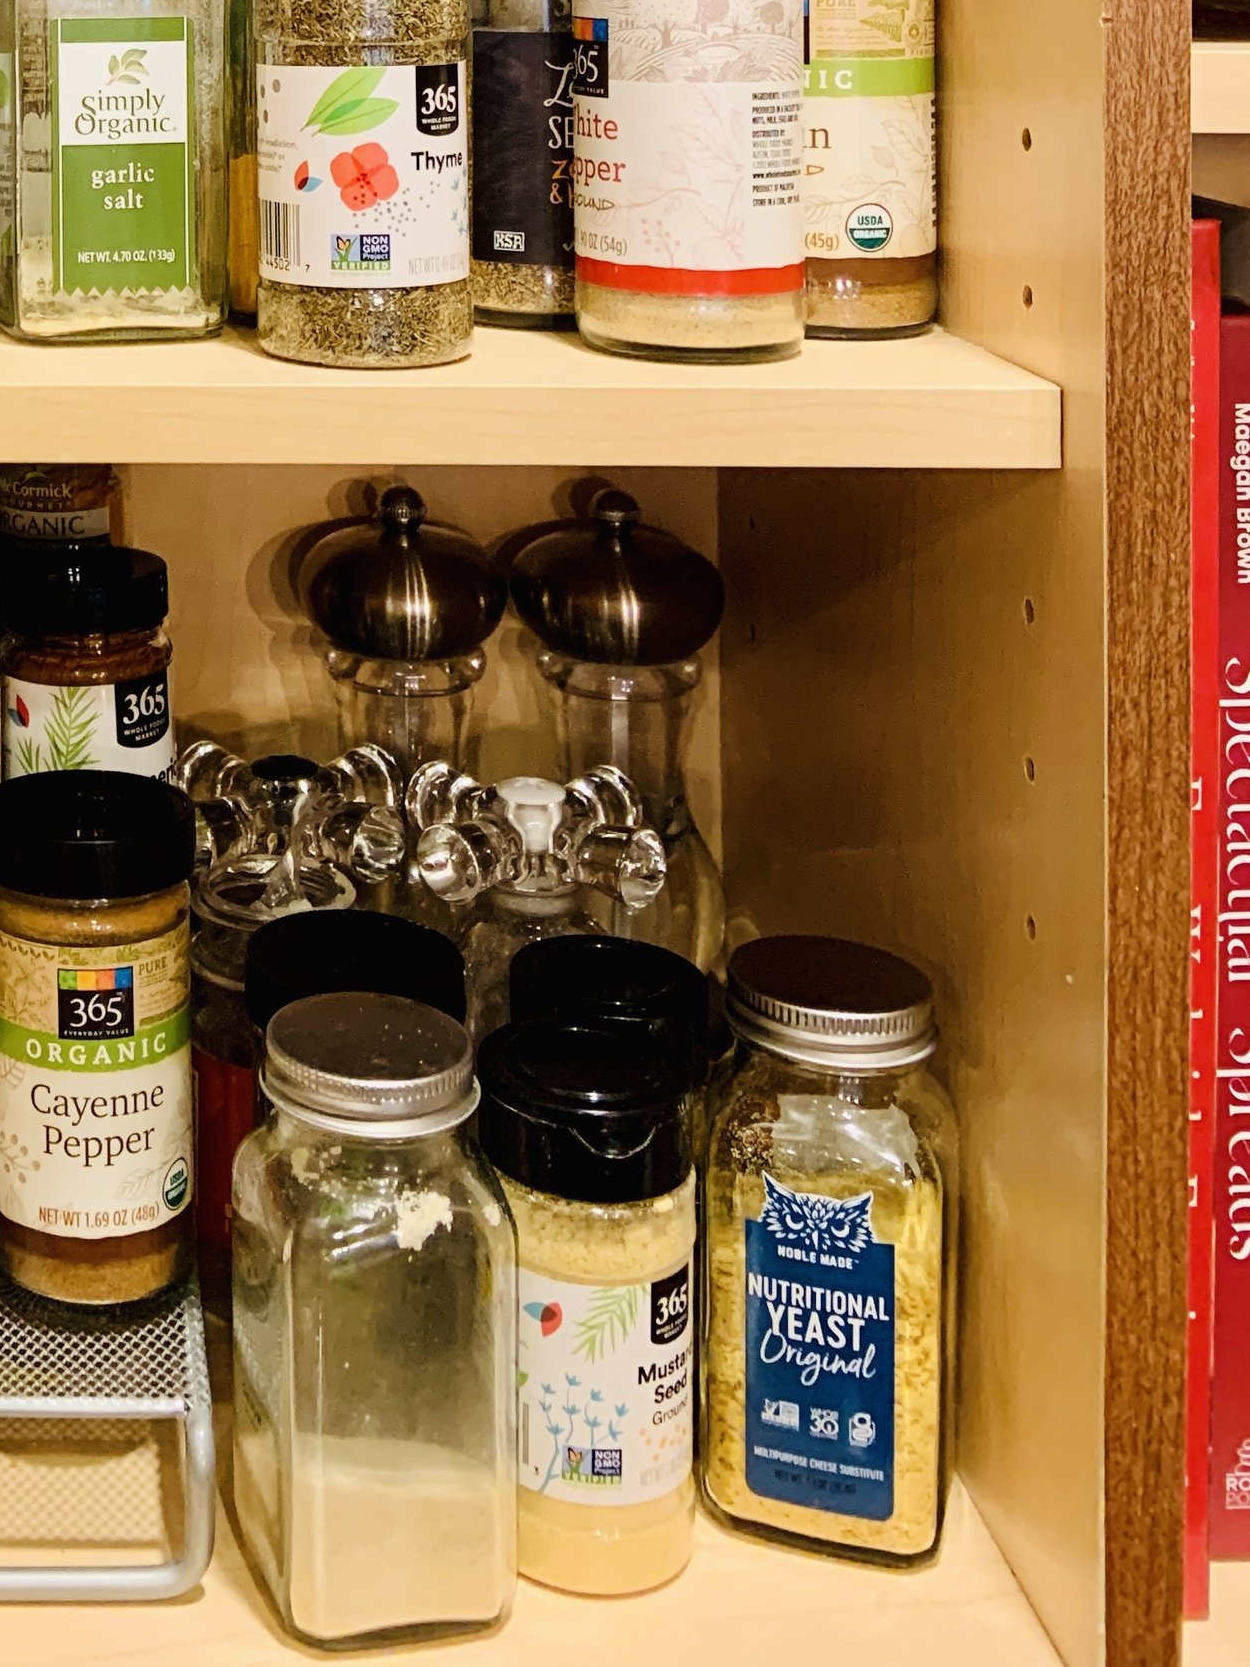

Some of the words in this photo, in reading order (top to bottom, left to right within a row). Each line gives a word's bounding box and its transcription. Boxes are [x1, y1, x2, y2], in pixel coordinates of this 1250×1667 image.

[81, 88, 166, 117] Simply
[421, 83, 457, 115] 365
[74, 113, 171, 141] Organic
[91, 162, 156, 189] garlic
[411, 151, 463, 174] Thyme
[103, 189, 144, 210] salt
[853, 228, 888, 239] ORGANIC
[857, 215, 884, 226] USDA
[362, 236, 389, 245] NON
[363, 244, 389, 254] GMO
[600, 235, 627, 256] (54g)
[805, 232, 840, 251] (45g)
[96, 251, 112, 263] WT.
[112, 251, 131, 262] 4.70
[133, 251, 147, 262] OZ.
[149, 248, 175, 263] (133g)
[332, 261, 391, 271] VERIFIED
[363, 253, 389, 261] Project
[122, 683, 166, 724] 365
[135, 729, 160, 741] MARKET
[138, 956, 168, 976] PURE
[69, 993, 123, 1028] 365
[25, 1031, 167, 1066] ORGANIC
[30, 1083, 164, 1127] Cayenne
[43, 1124, 156, 1168] Pepper
[84, 1211, 110, 1227] 1.69
[131, 1201, 160, 1225] (48g)
[777, 1245, 817, 1264] NOBLE
[819, 1253, 854, 1270] MADE
[655, 1283, 688, 1325] 365
[748, 1272, 890, 1322] NUTRITIONAL
[765, 1301, 866, 1352] YEAST
[759, 1327, 876, 1387] Original
[654, 1368, 687, 1404] Seed
[652, 1394, 688, 1426] Ground
[594, 1450, 621, 1460] NON
[594, 1459, 621, 1468] GMO
[753, 1445, 808, 1468] MULTIPURPOSE
[809, 1458, 838, 1475] CHEESE
[839, 1463, 884, 1482] SUBSTITUTE
